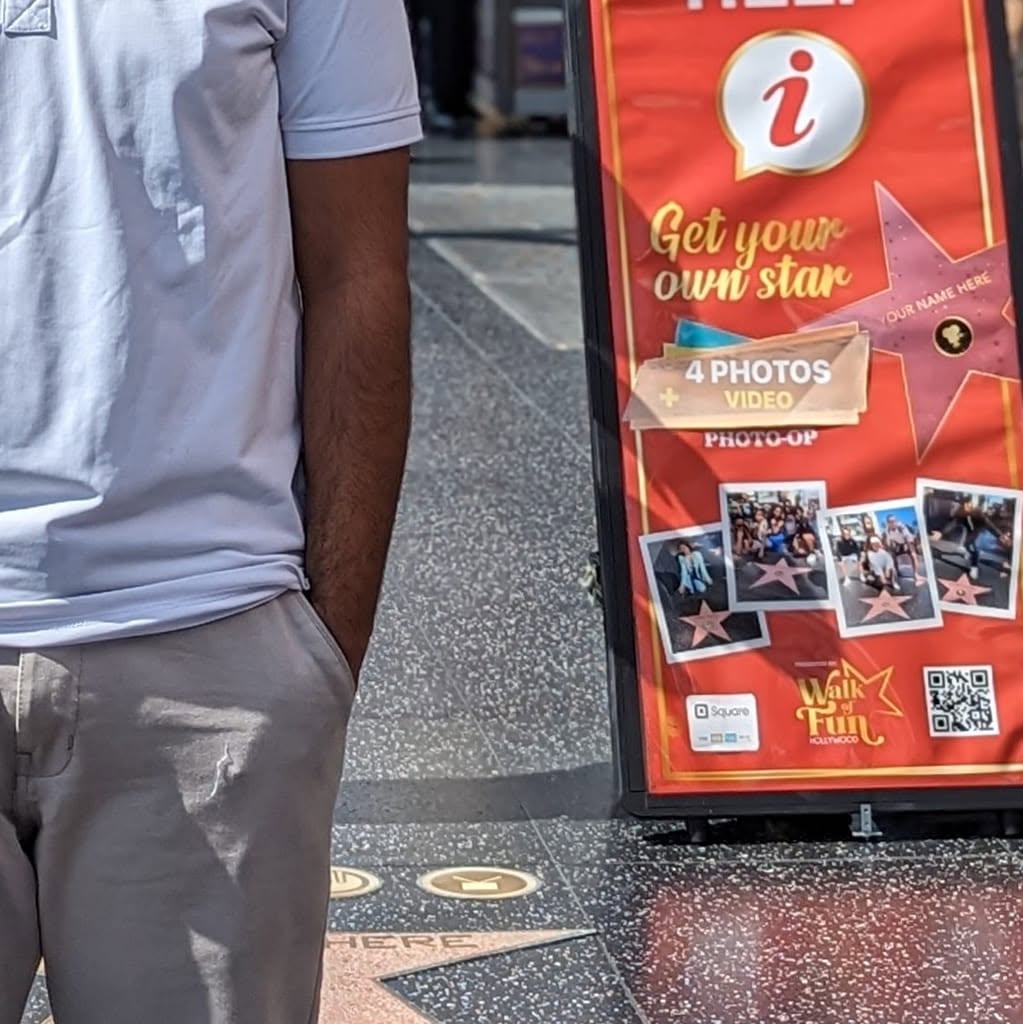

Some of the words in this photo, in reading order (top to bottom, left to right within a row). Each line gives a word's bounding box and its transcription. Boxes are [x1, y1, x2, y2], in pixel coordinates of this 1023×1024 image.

[650, 201, 726, 262] Get
[735, 217, 847, 270] your
[654, 268, 750, 301] own
[756, 254, 852, 299] star
[915, 287, 956, 311] NAME
[956, 270, 993, 294] HERE
[684, 359, 705, 384] 4
[711, 359, 832, 385] PHOTOS
[724, 389, 795, 409] VIDEO
[704, 429, 819, 448] PHOTO-OP
[797, 670, 866, 707] Walk
[710, 705, 750, 718] Square
[796, 700, 885, 746] Fun
